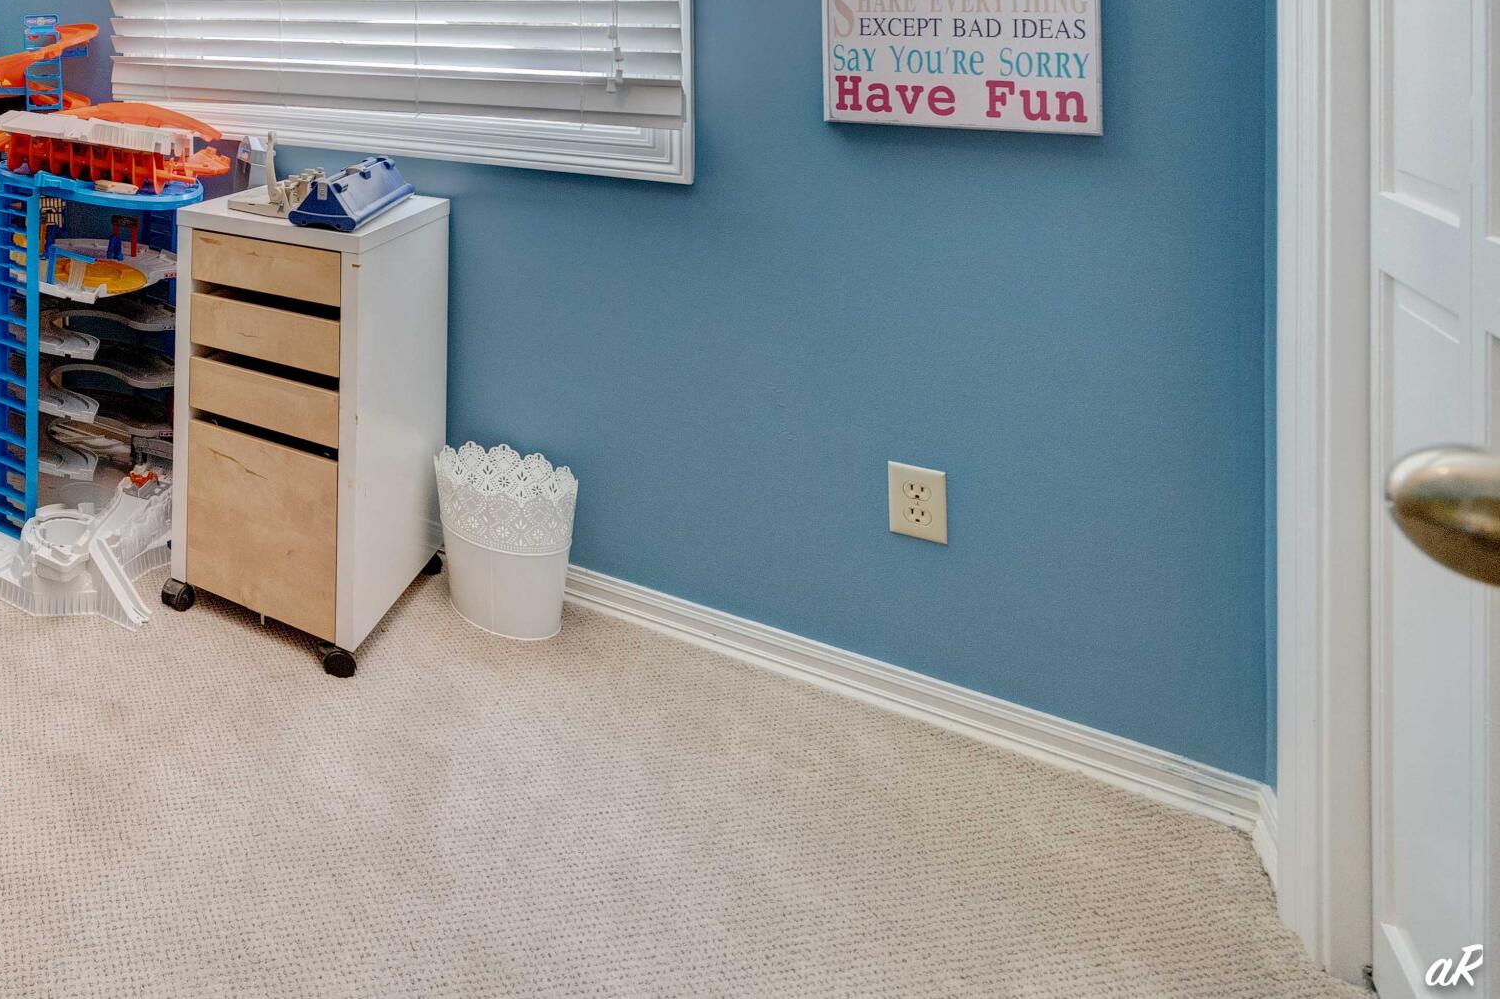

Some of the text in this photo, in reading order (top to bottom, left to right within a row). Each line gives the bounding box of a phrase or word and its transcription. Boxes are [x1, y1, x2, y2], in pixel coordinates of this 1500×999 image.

[859, 17, 1086, 39] EXCEPT BAD IDEAS
[835, 75, 1088, 123] Have Fun
